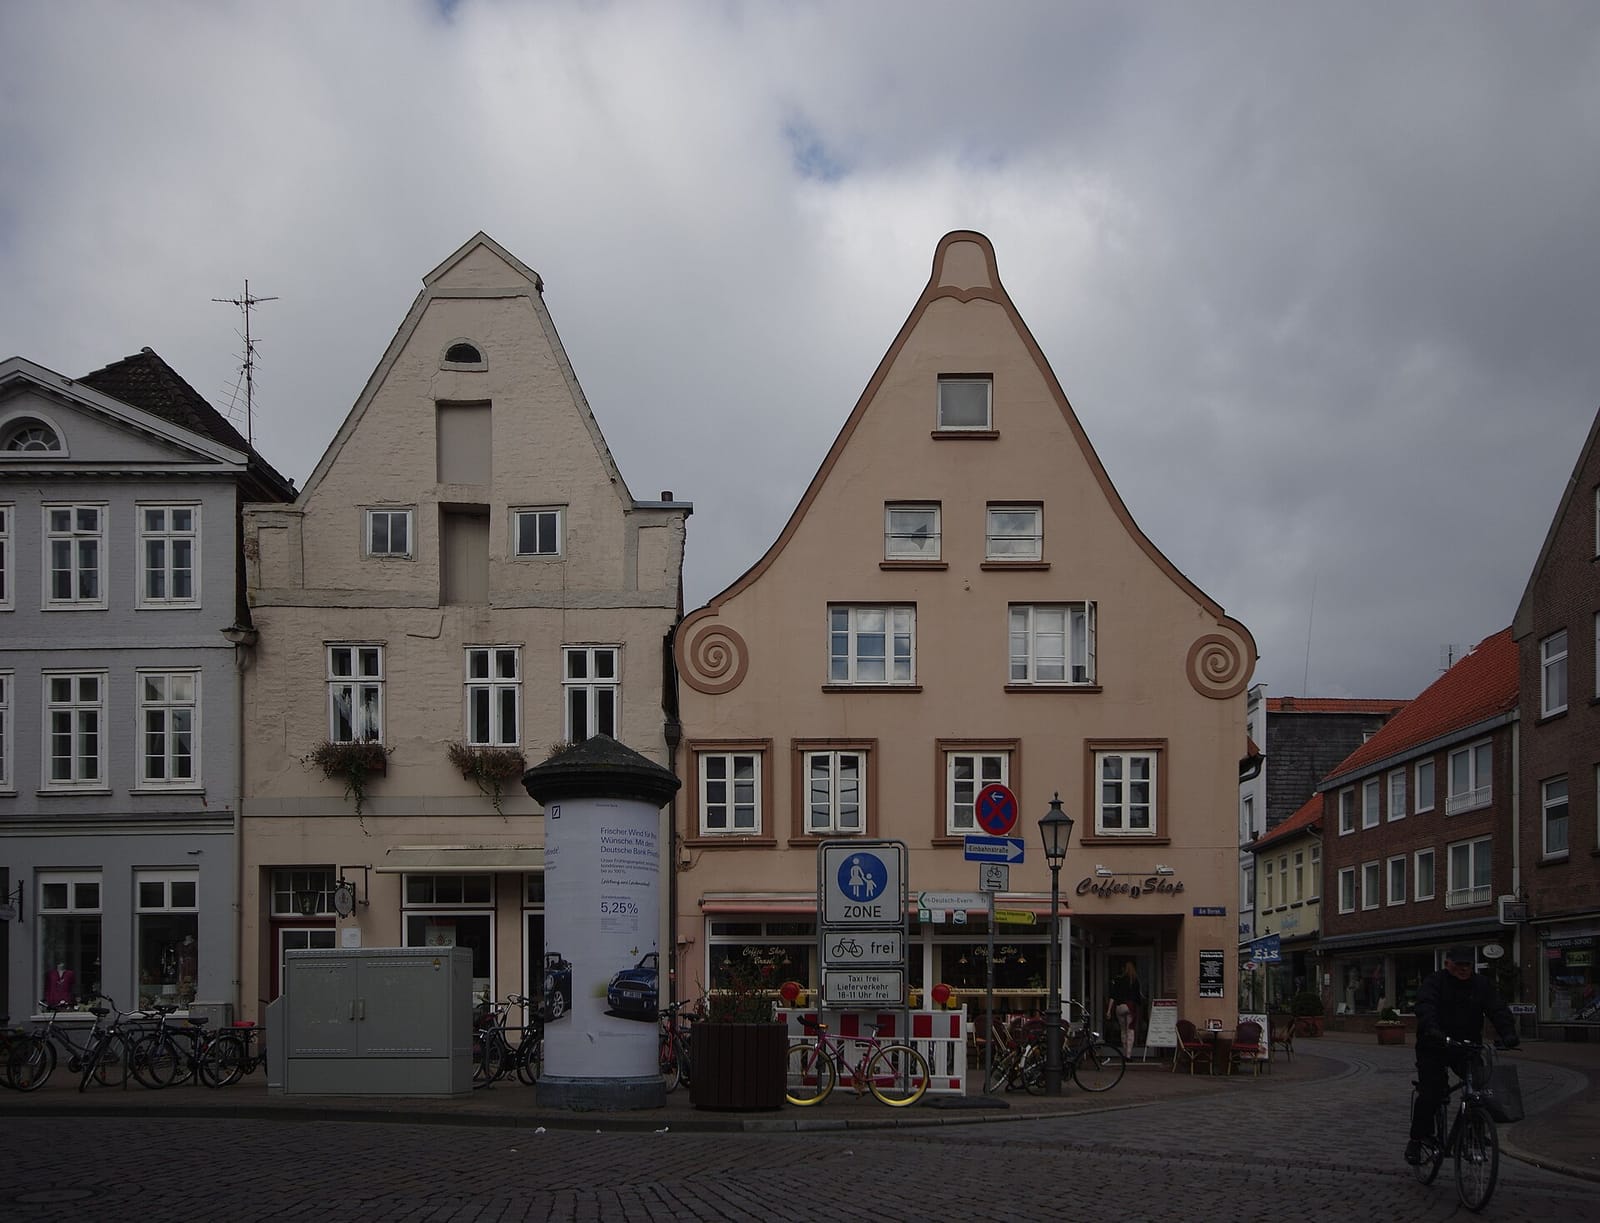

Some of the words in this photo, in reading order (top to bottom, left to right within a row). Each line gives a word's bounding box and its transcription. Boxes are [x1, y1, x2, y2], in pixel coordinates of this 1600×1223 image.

[600, 827, 627, 836] Frischer
[628, 829, 644, 837] Wind
[600, 845, 632, 855] Deutsche
[633, 847, 646, 856] Bank
[968, 845, 1008, 854] Einbahnstraße
[1076, 877, 1130, 898] Coffee
[1142, 877, 1185, 898] Shop
[600, 902, 639, 915] 5,25%
[844, 905, 882, 918] ZONE
[769, 946, 786, 956] Shop
[871, 940, 894, 954] frei
[1000, 945, 1018, 955] Shop
[1252, 948, 1278, 960] Eis
[848, 975, 863, 983] Taxi
[866, 975, 879, 983] frei
[837, 983, 889, 991] Lieferverkehr
[858, 991, 872, 999] Uhr
[876, 991, 889, 999] frei
